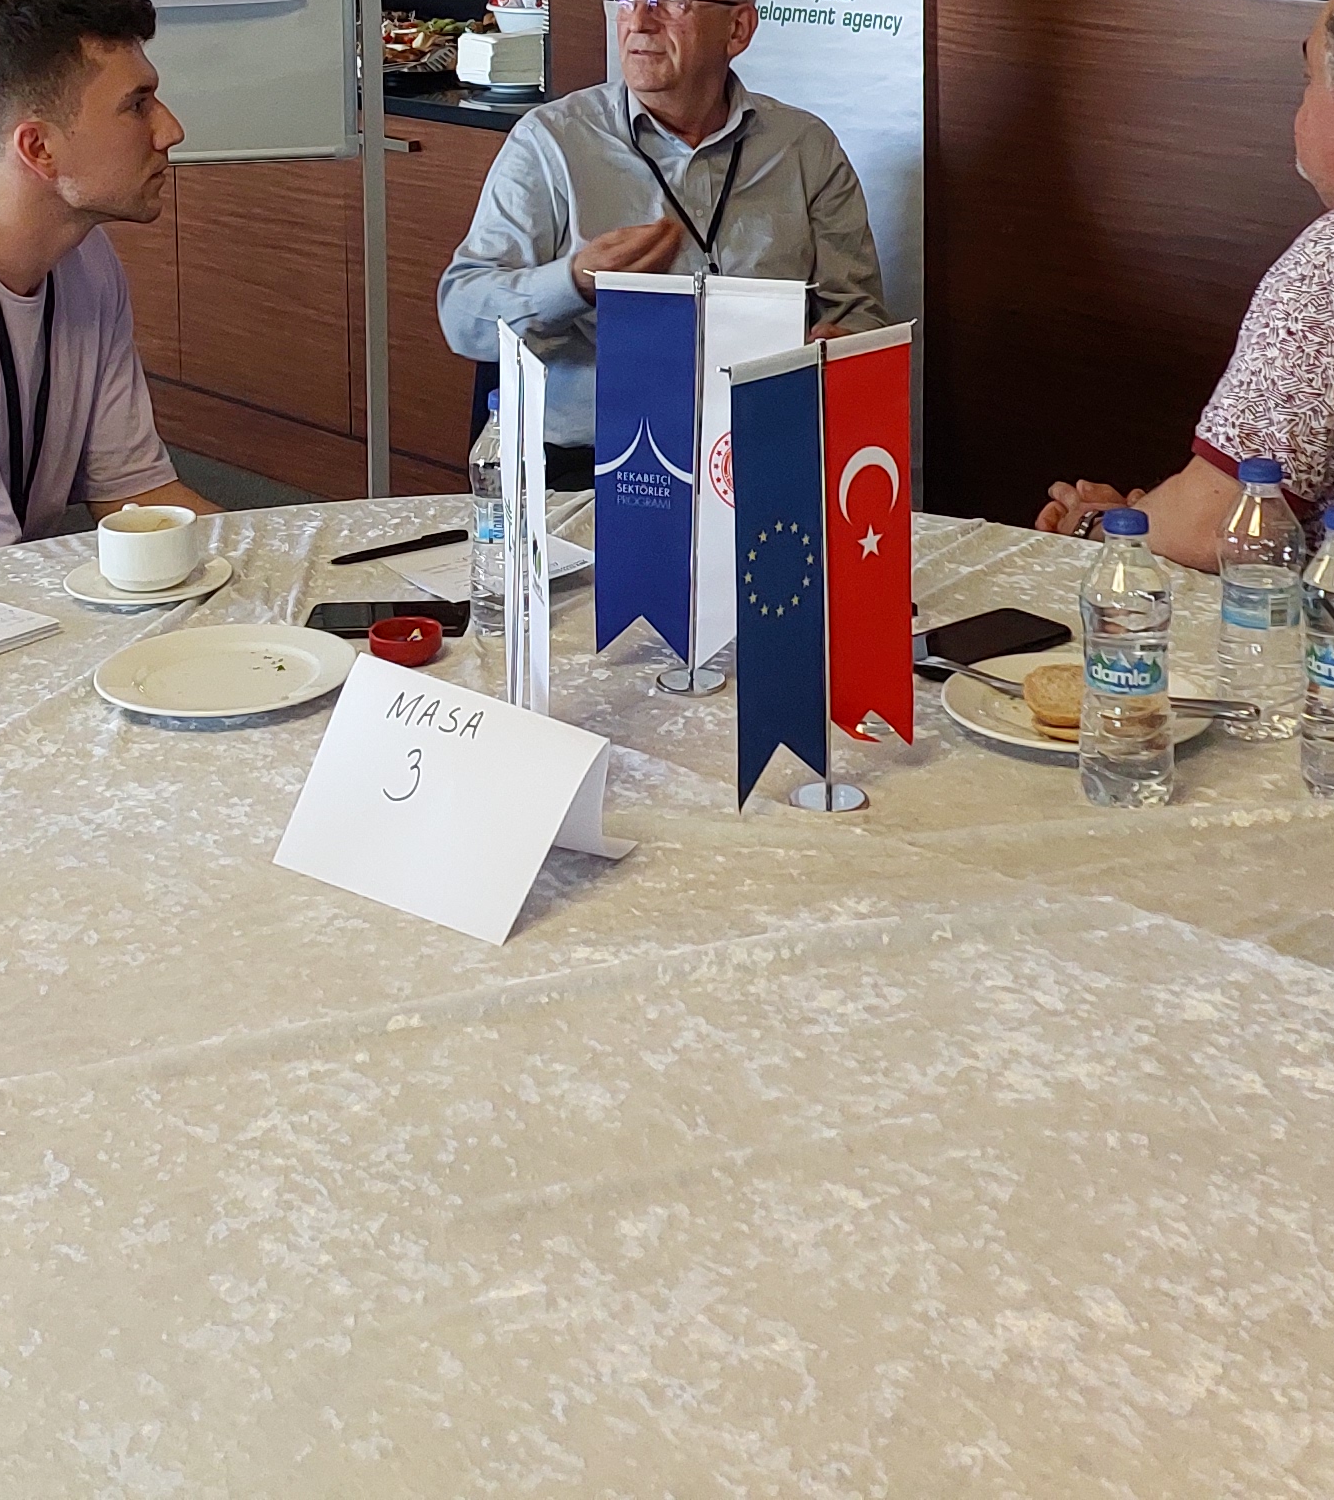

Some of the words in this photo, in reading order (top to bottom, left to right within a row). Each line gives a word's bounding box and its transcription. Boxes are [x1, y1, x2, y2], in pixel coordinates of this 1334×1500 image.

[842, 11, 903, 36] agency
[616, 471, 671, 486] REKABETÇİ
[616, 483, 671, 497] SEKTÖRLER
[1092, 663, 1151, 686] damla
[386, 691, 484, 739] MASA
[383, 748, 422, 802] 3
